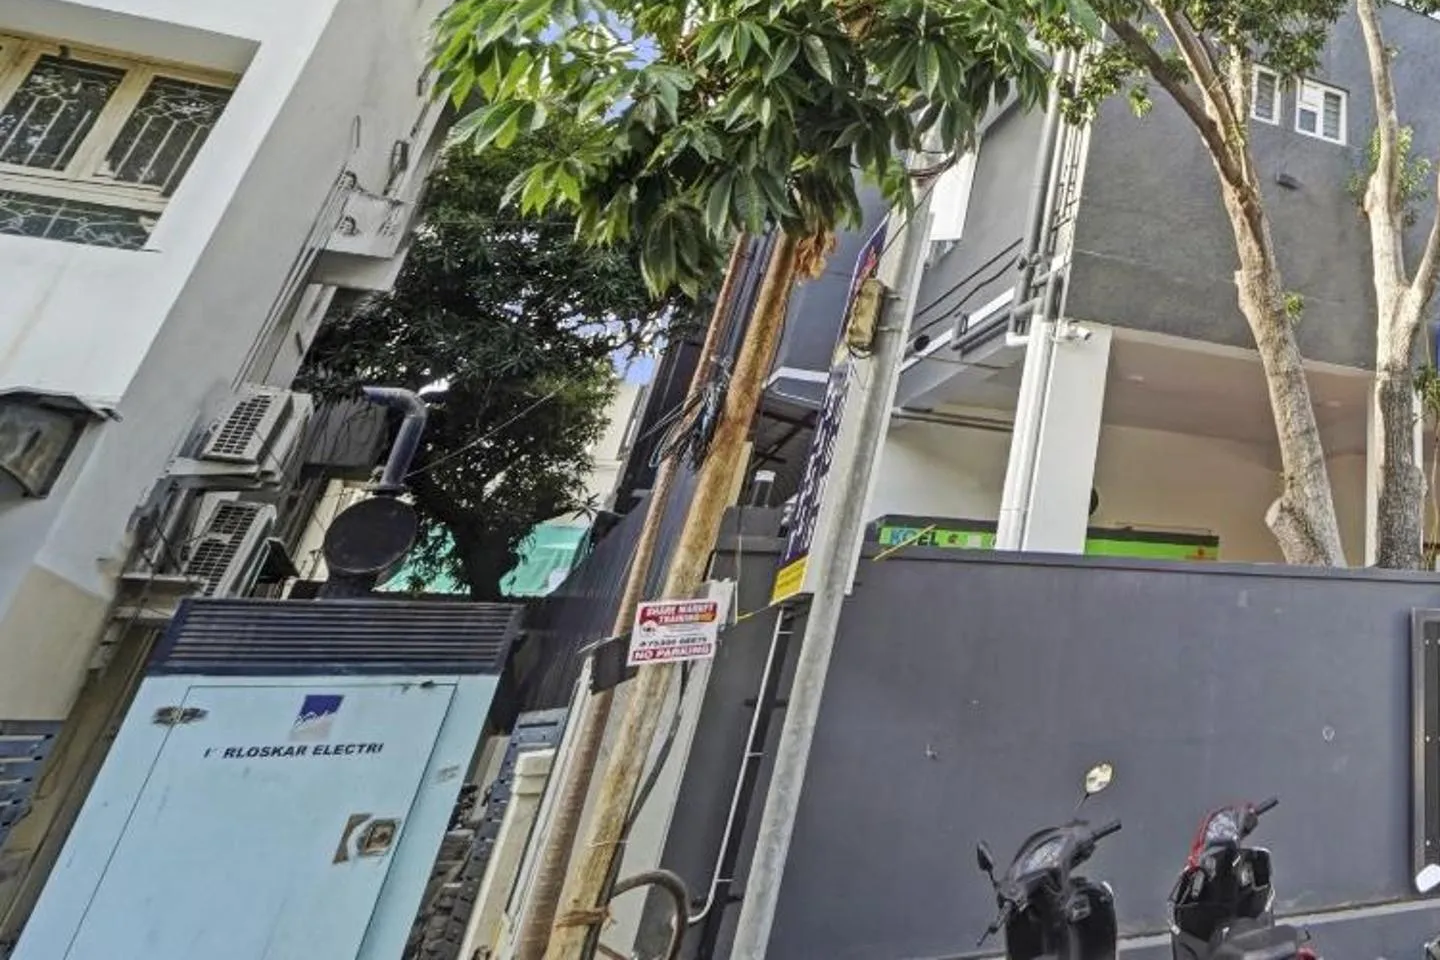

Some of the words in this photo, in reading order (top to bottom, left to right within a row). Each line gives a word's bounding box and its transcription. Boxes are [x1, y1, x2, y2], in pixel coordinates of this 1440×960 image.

[633, 649, 654, 660] NO
[655, 644, 711, 658] PARKING
[204, 744, 306, 759] RLOSKAR
